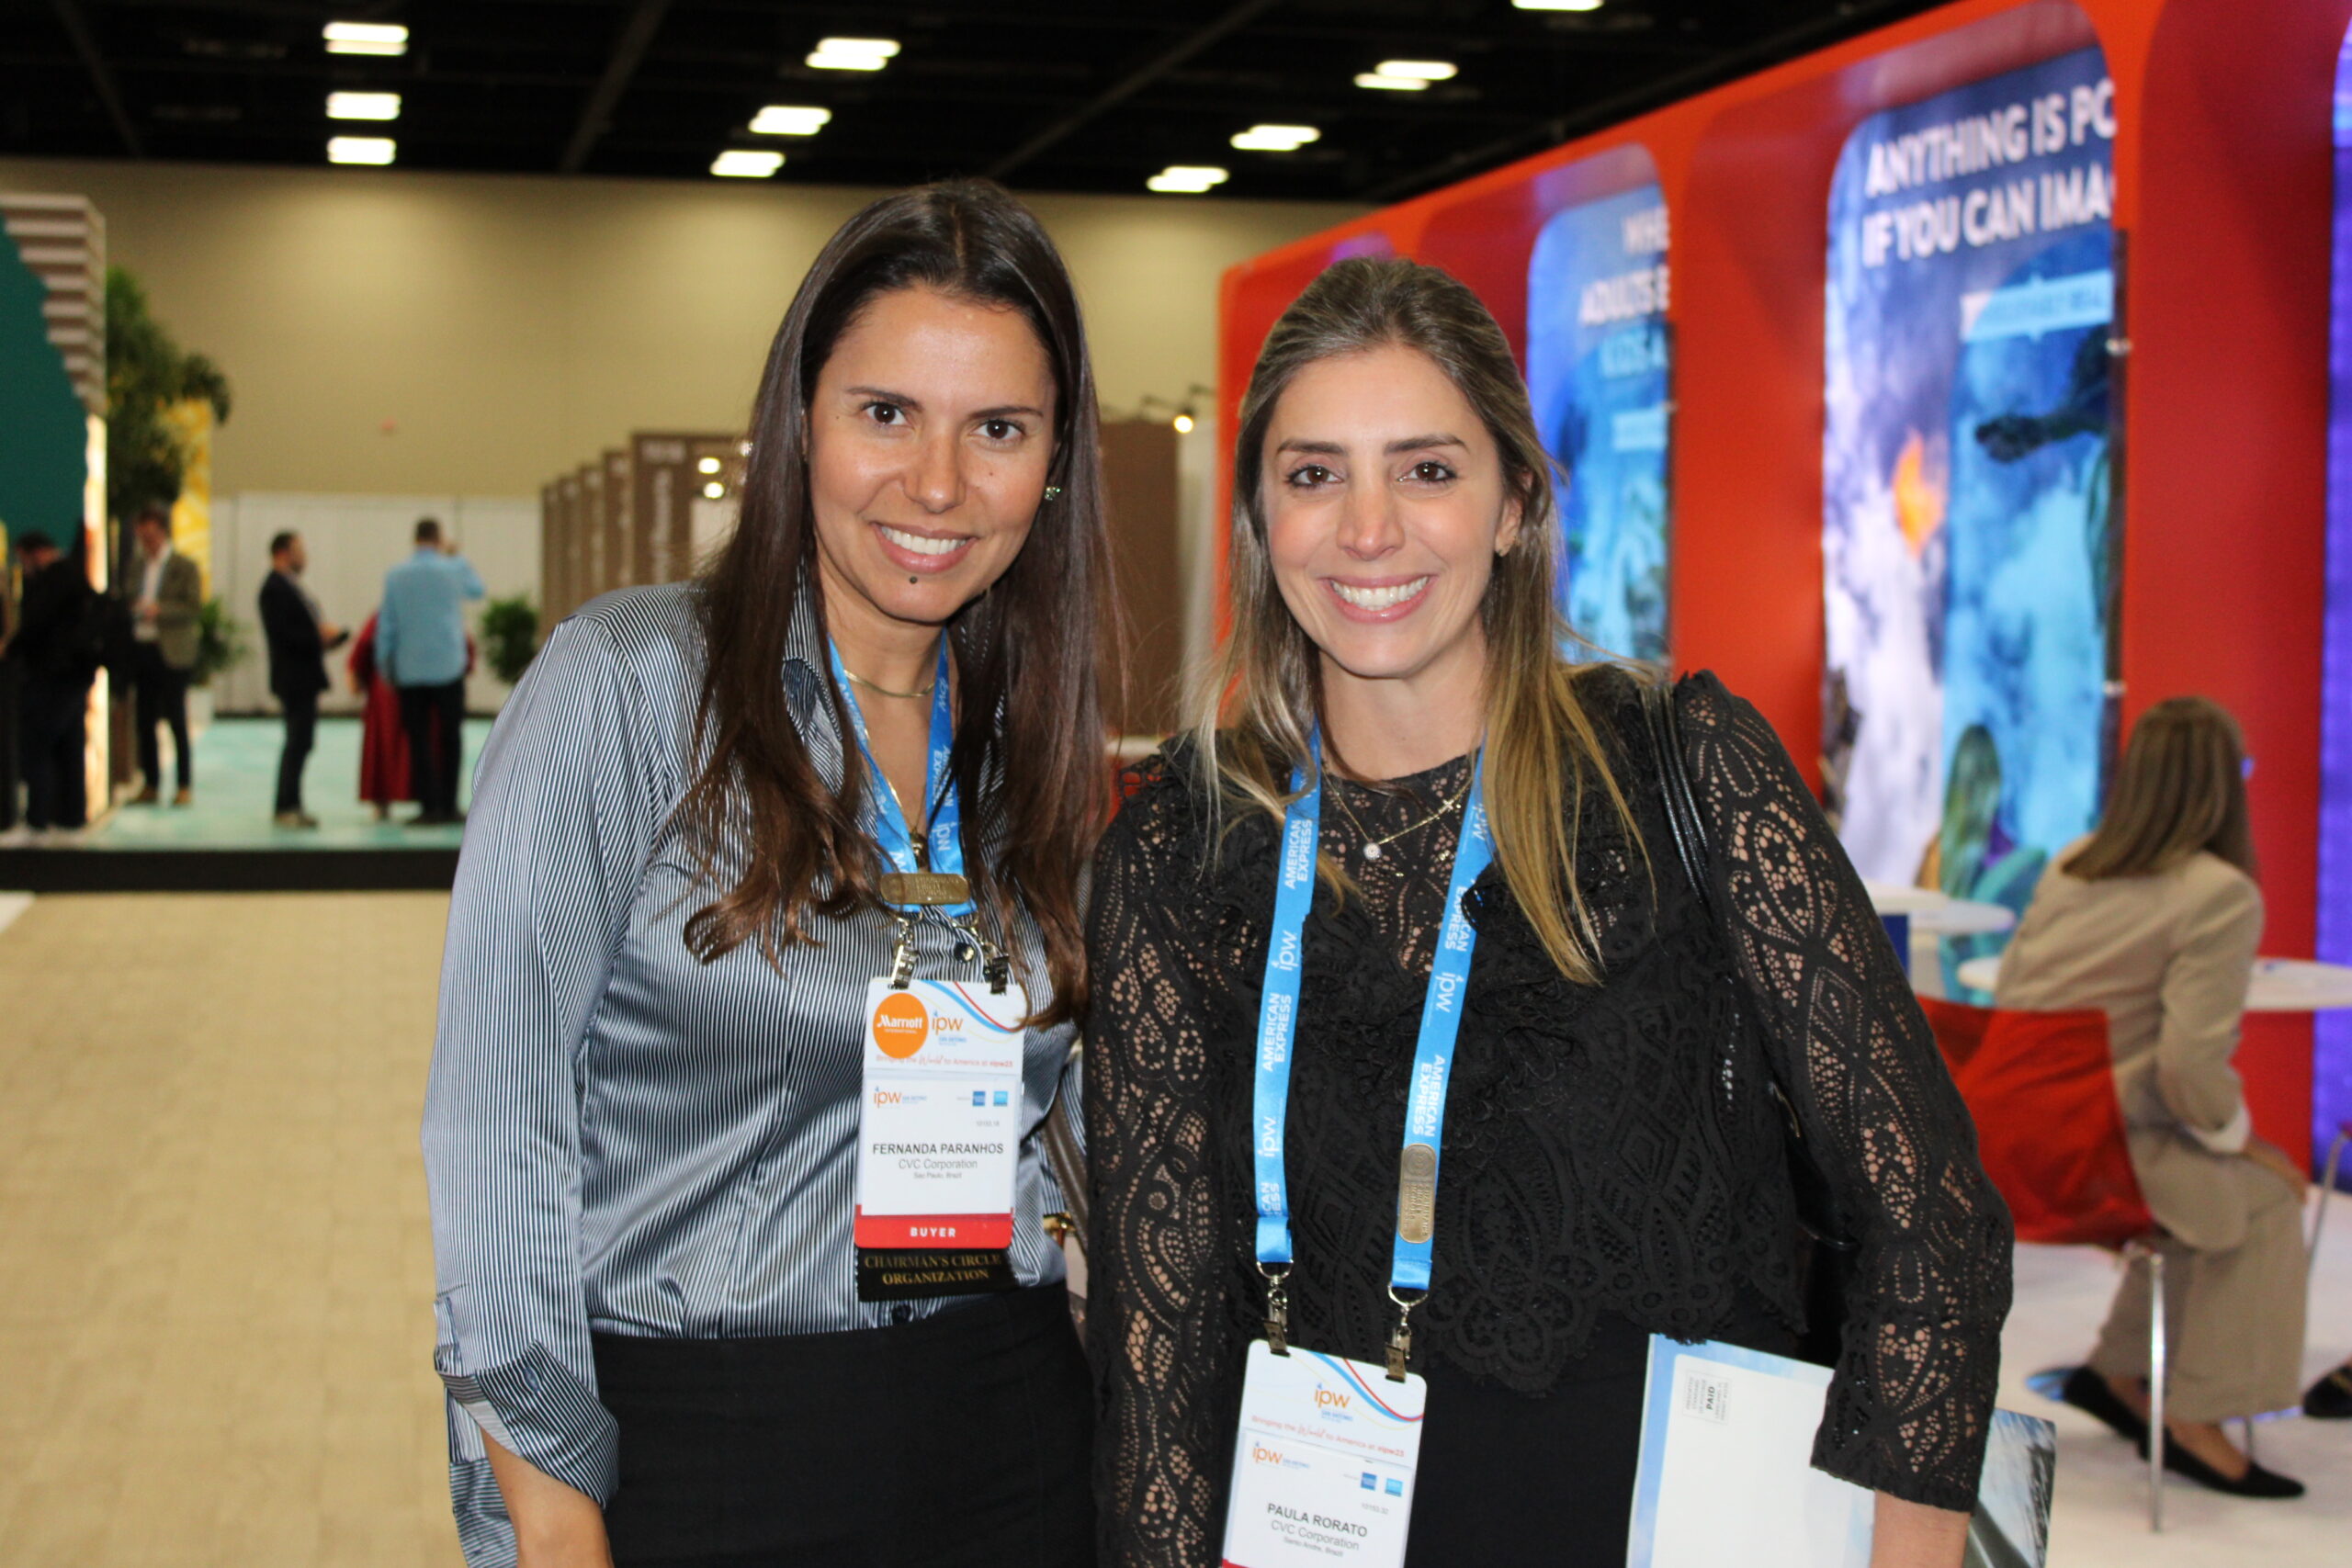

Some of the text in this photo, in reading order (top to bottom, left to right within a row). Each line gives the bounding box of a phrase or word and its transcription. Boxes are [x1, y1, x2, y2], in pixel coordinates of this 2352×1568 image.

[1863, 104, 2029, 199] ANYTHING
[2032, 93, 2067, 156] IS
[1862, 210, 1894, 268] IF
[1894, 196, 1961, 261] YOU
[1963, 179, 2036, 246] CAN
[933, 822, 957, 852] ipw
[1296, 818, 1313, 882] EXPRESS
[1284, 819, 1302, 889] AMERICAN
[1272, 930, 1298, 972] ipw
[1435, 971, 1464, 1013] ipw
[876, 1014, 923, 1030] Marriott
[932, 1011, 964, 1035] ipw
[1262, 992, 1281, 1072] AMERICAN
[1274, 994, 1293, 1063] EXPRESS
[874, 1086, 902, 1108] ipw
[1413, 1062, 1432, 1135] EXPRESS
[1425, 1055, 1446, 1137] AMERICAN
[873, 1143, 1004, 1155] FERNANDA PARANHOS
[1257, 1116, 1281, 1157] ipw
[899, 1157, 978, 1171] CVC Corporation
[910, 1226, 957, 1237] BUYER
[864, 1254, 1002, 1269] CHAIRMAN'S CIRCLE
[882, 1269, 990, 1286] ORGANIZATION
[1314, 1383, 1351, 1409] ipw
[1706, 1386, 1715, 1410] PAID
[1252, 1442, 1283, 1464] ipw
[1336, 1435, 1367, 1448] America
[1267, 1503, 1368, 1538] PAULA RORATO
[1271, 1519, 1360, 1551] CVC Corporation
